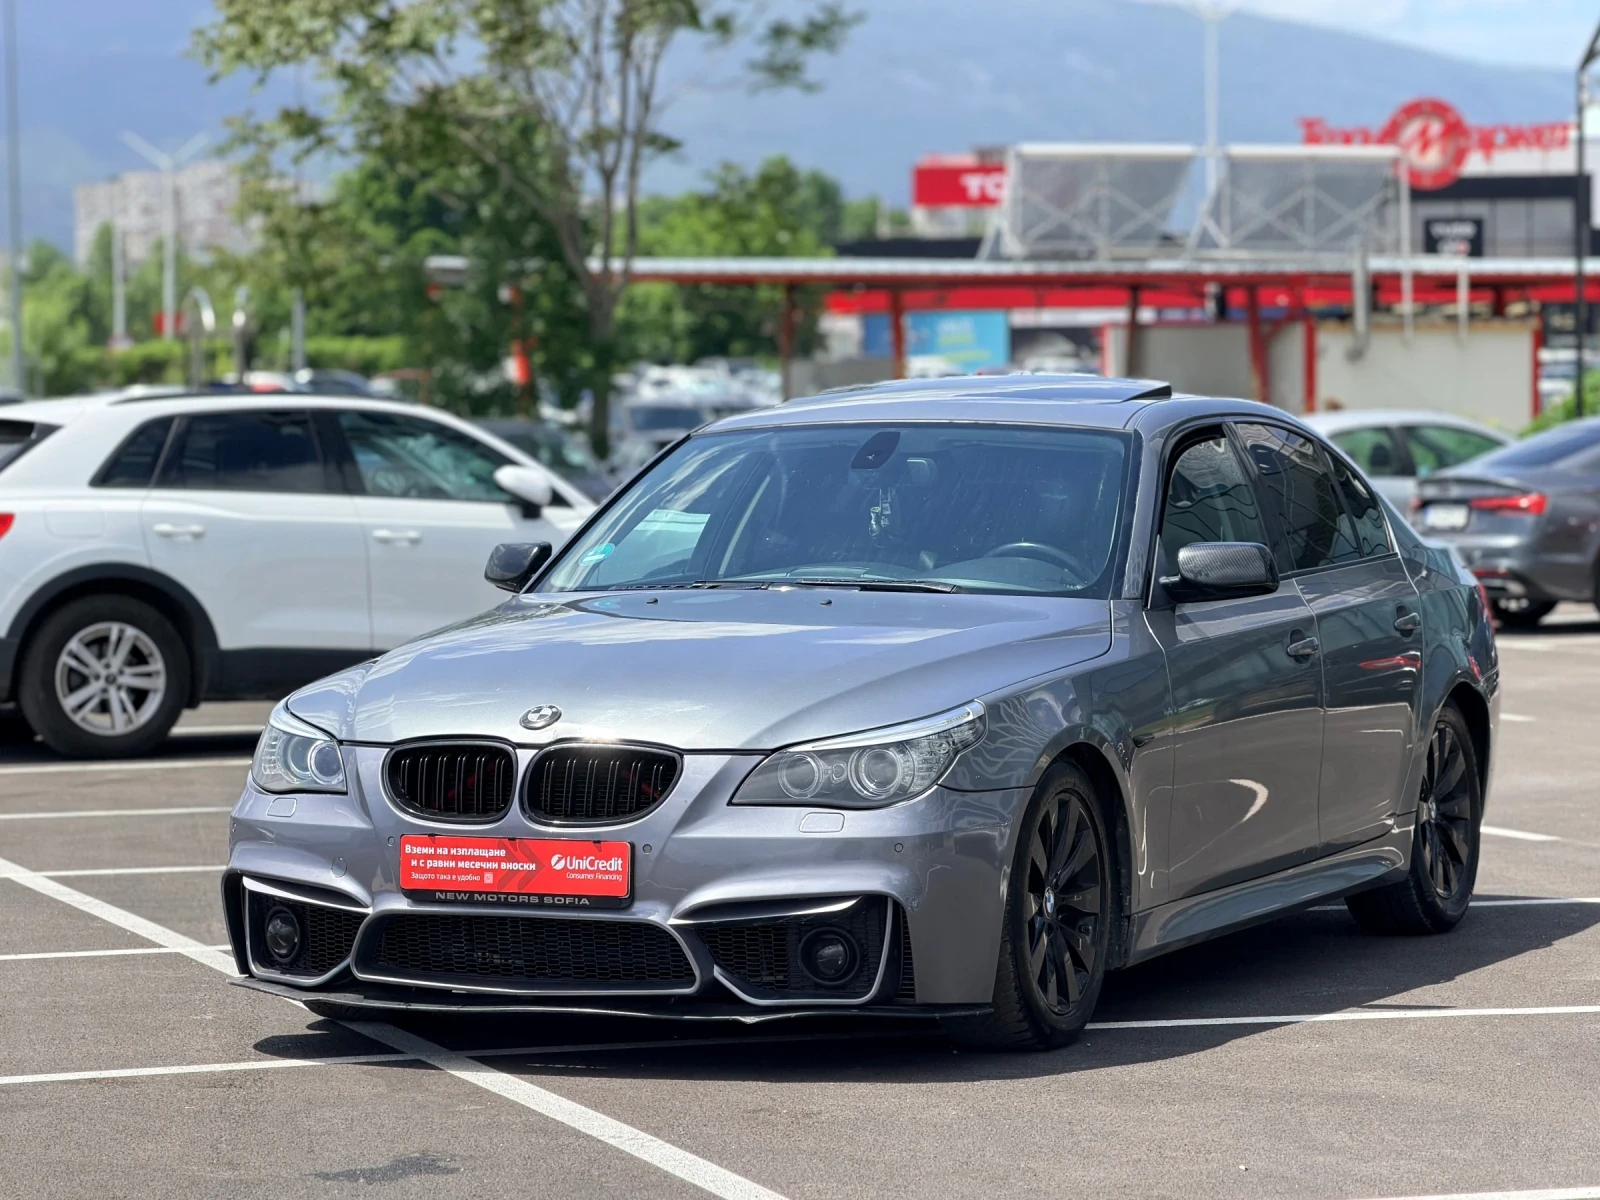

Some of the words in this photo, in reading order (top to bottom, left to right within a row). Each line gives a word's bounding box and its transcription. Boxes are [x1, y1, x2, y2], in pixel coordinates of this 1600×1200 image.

[405, 844, 434, 855] Вземи
[437, 847, 448, 855] на
[450, 847, 506, 858] изплащане
[411, 859, 418, 867] и
[419, 859, 425, 867] с
[426, 859, 456, 869] равни
[458, 860, 499, 869] месечни
[501, 862, 536, 871] вноски
[566, 856, 623, 871] UniCredit
[410, 872, 435, 880] Защото
[595, 873, 623, 882] Financing
[435, 892, 470, 900] NEW
[474, 893, 540, 903] MOTORS
[543, 896, 590, 905] SOFIA
